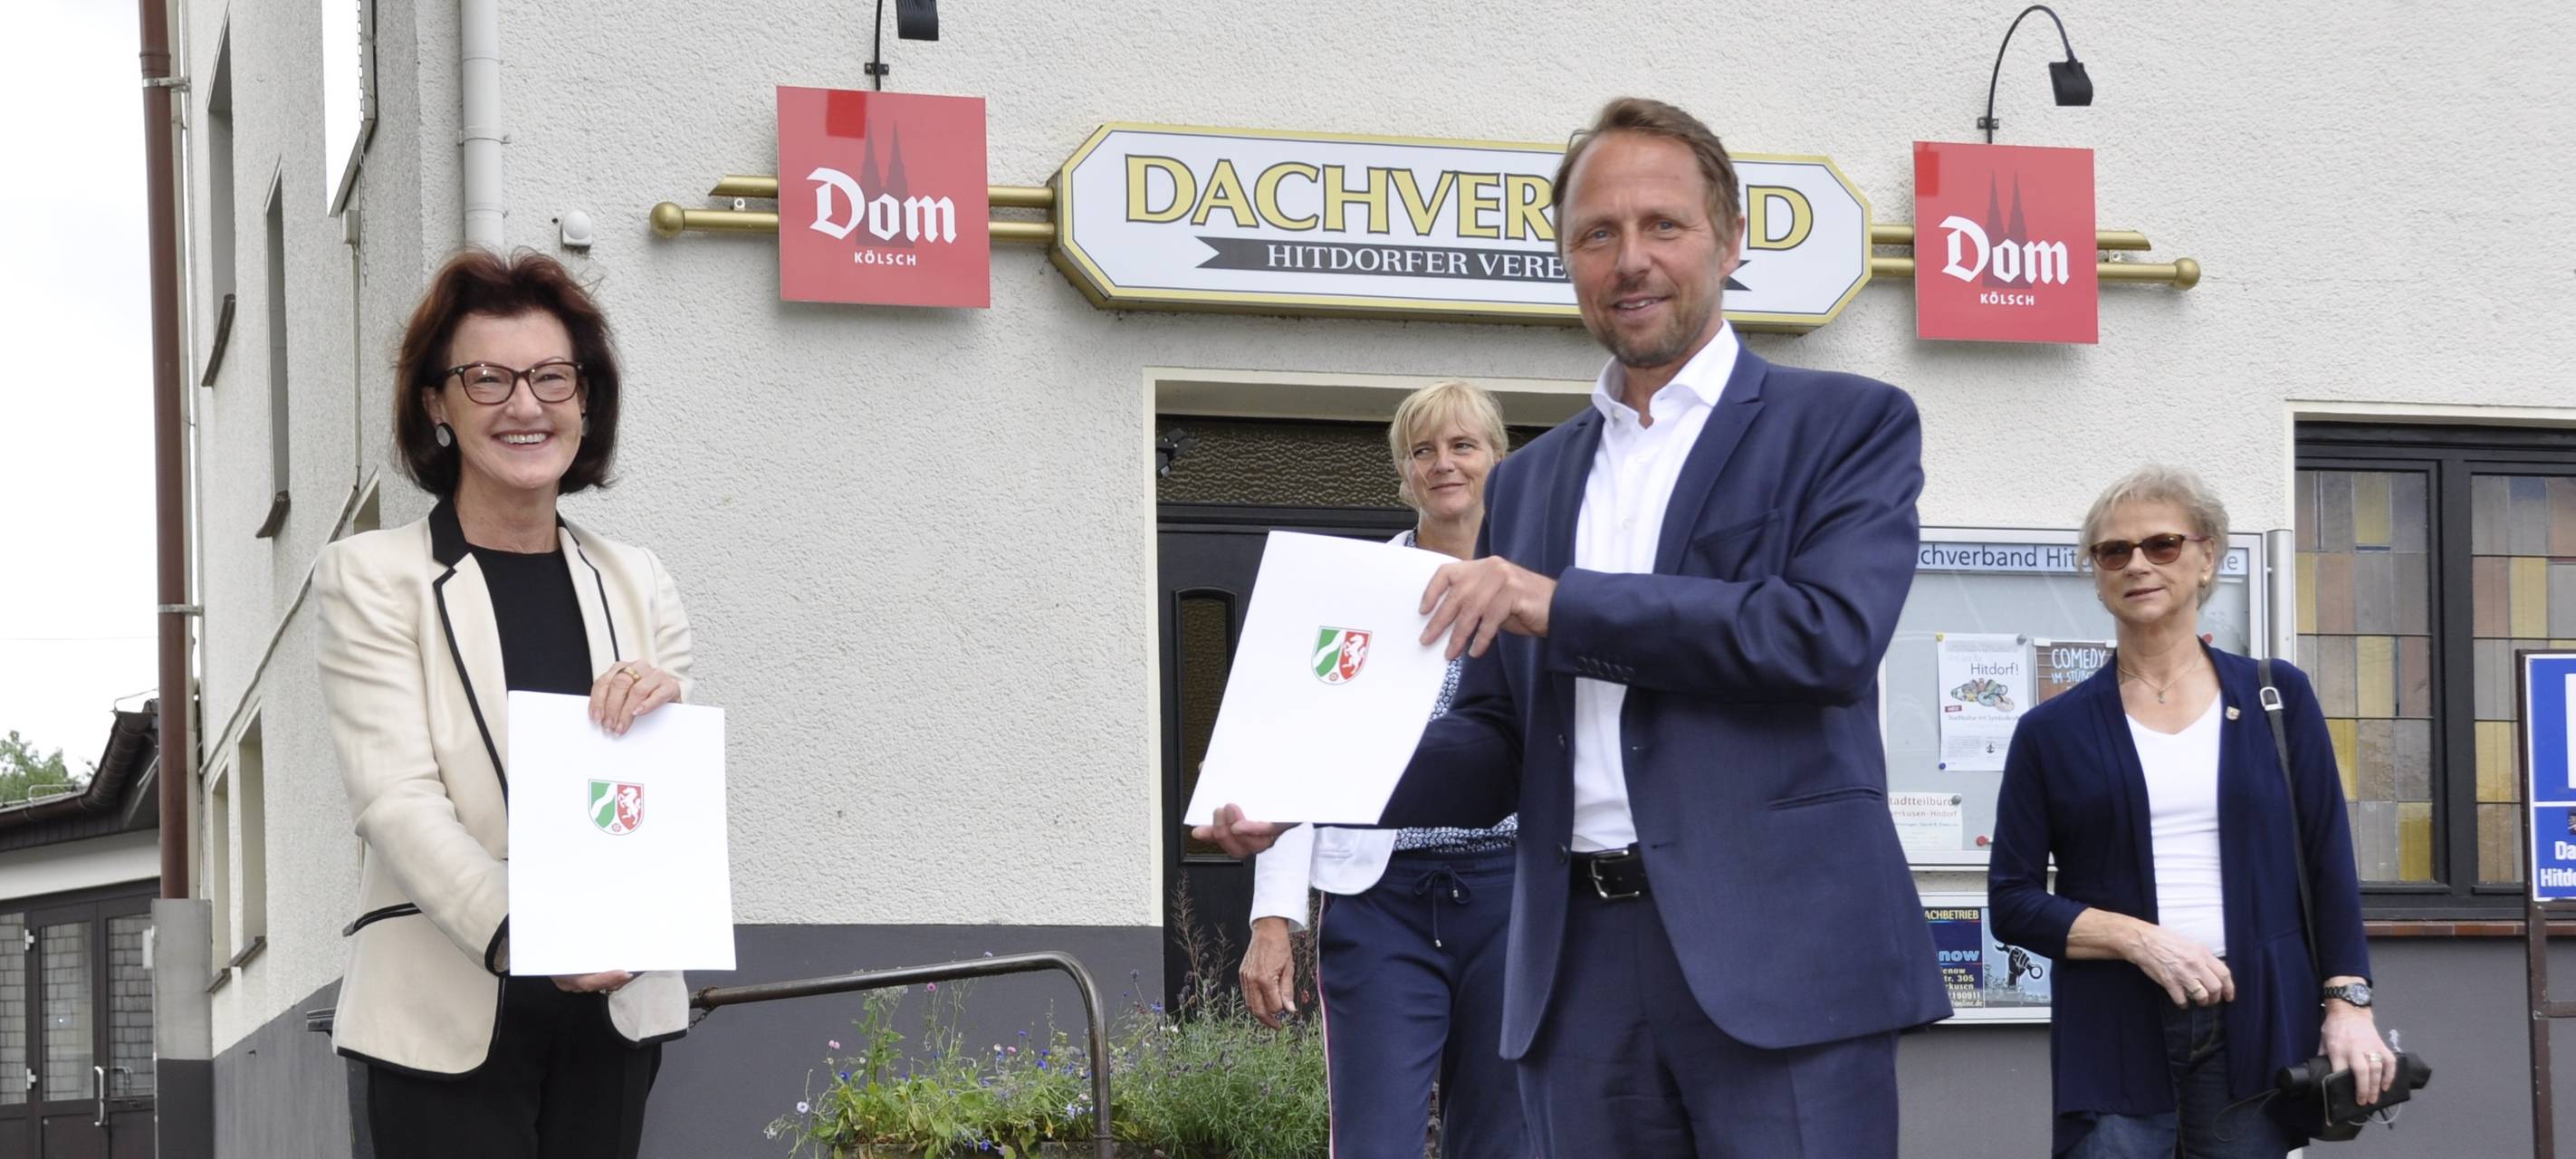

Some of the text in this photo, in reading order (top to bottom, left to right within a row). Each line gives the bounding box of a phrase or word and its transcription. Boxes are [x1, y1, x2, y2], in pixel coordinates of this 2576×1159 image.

[806, 167, 957, 244] Dom
[1125, 153, 1814, 251] DACHVERD
[854, 250, 916, 266] KÖLSCH
[1939, 216, 2070, 284] Dom
[1268, 244, 1566, 279] HITDORFER VERE
[1980, 291, 2035, 305] KÖLSCH
[1920, 543, 2091, 568] chverband Hit
[2052, 647, 2106, 669] COMEDY
[1970, 662, 2019, 675] Hitdorf!
[1889, 796, 1952, 806] tadtteilbür
[2554, 839, 2576, 860] Da
[2540, 867, 2576, 887] Hitd
[1925, 909, 1979, 920] ACHBETRIEB
[1938, 950, 1980, 962] now
[1944, 974, 1975, 982] tr. 305
